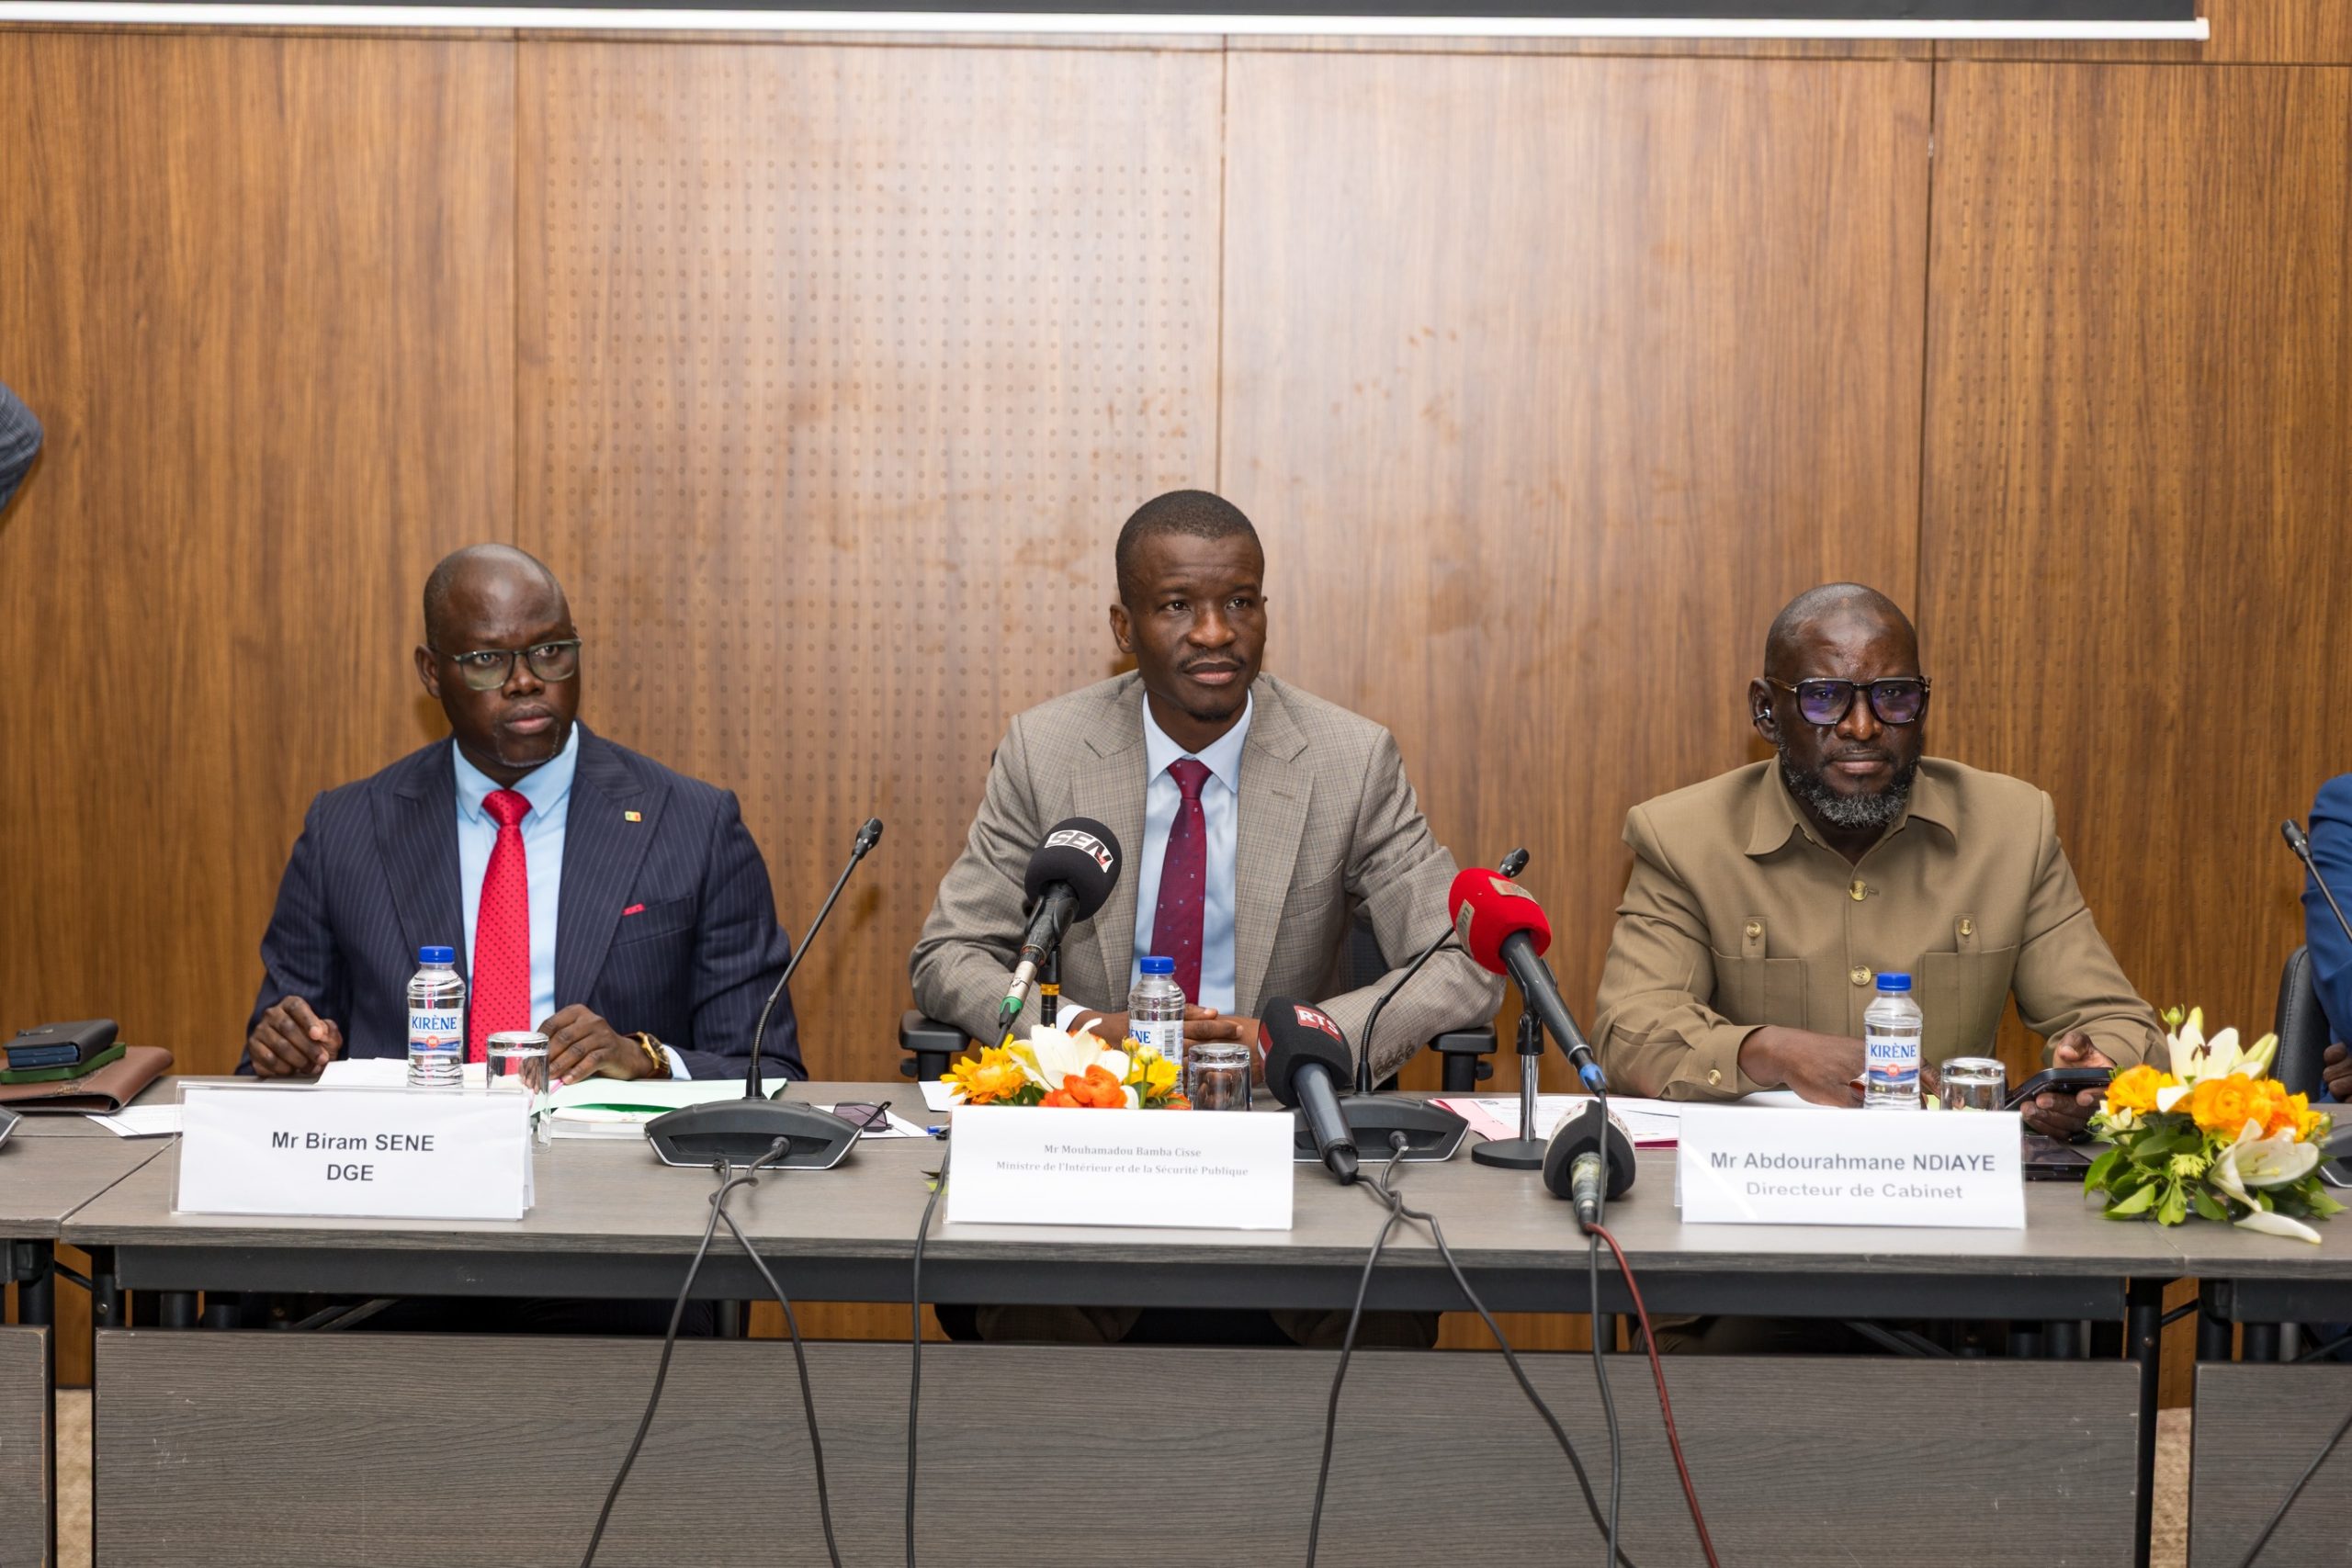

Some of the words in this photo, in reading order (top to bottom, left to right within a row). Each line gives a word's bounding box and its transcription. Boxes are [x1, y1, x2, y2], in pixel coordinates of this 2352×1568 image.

[1047, 830, 1113, 866] SEN
[412, 1014, 458, 1030] KIRÈNE
[1297, 1010, 1340, 1035] RTS
[1870, 1042, 1917, 1057] KIRÈNE
[271, 1131, 299, 1149] Mr
[305, 1132, 368, 1150] Biram
[375, 1134, 435, 1152] SENE
[1044, 1144, 1058, 1154] Mr
[1061, 1145, 1134, 1156] Mouhamadou
[1136, 1146, 1172, 1157] Bamba
[996, 1161, 1041, 1171] Ministre
[1043, 1162, 1056, 1171] de
[1114, 1165, 1125, 1173] et
[1127, 1164, 1141, 1174] de
[1143, 1164, 1153, 1174] la
[1155, 1165, 1199, 1175] Sécurité
[1201, 1166, 1249, 1178] Publique
[1711, 1152, 1737, 1169] Mr
[1743, 1152, 1906, 1171] Abdourahmane
[1913, 1154, 1996, 1172] NDIAYE
[326, 1164, 375, 1182] DGE
[1746, 1181, 1843, 1197] Directeur
[1849, 1182, 1875, 1198] de
[1882, 1183, 1963, 1200] Cabinet
